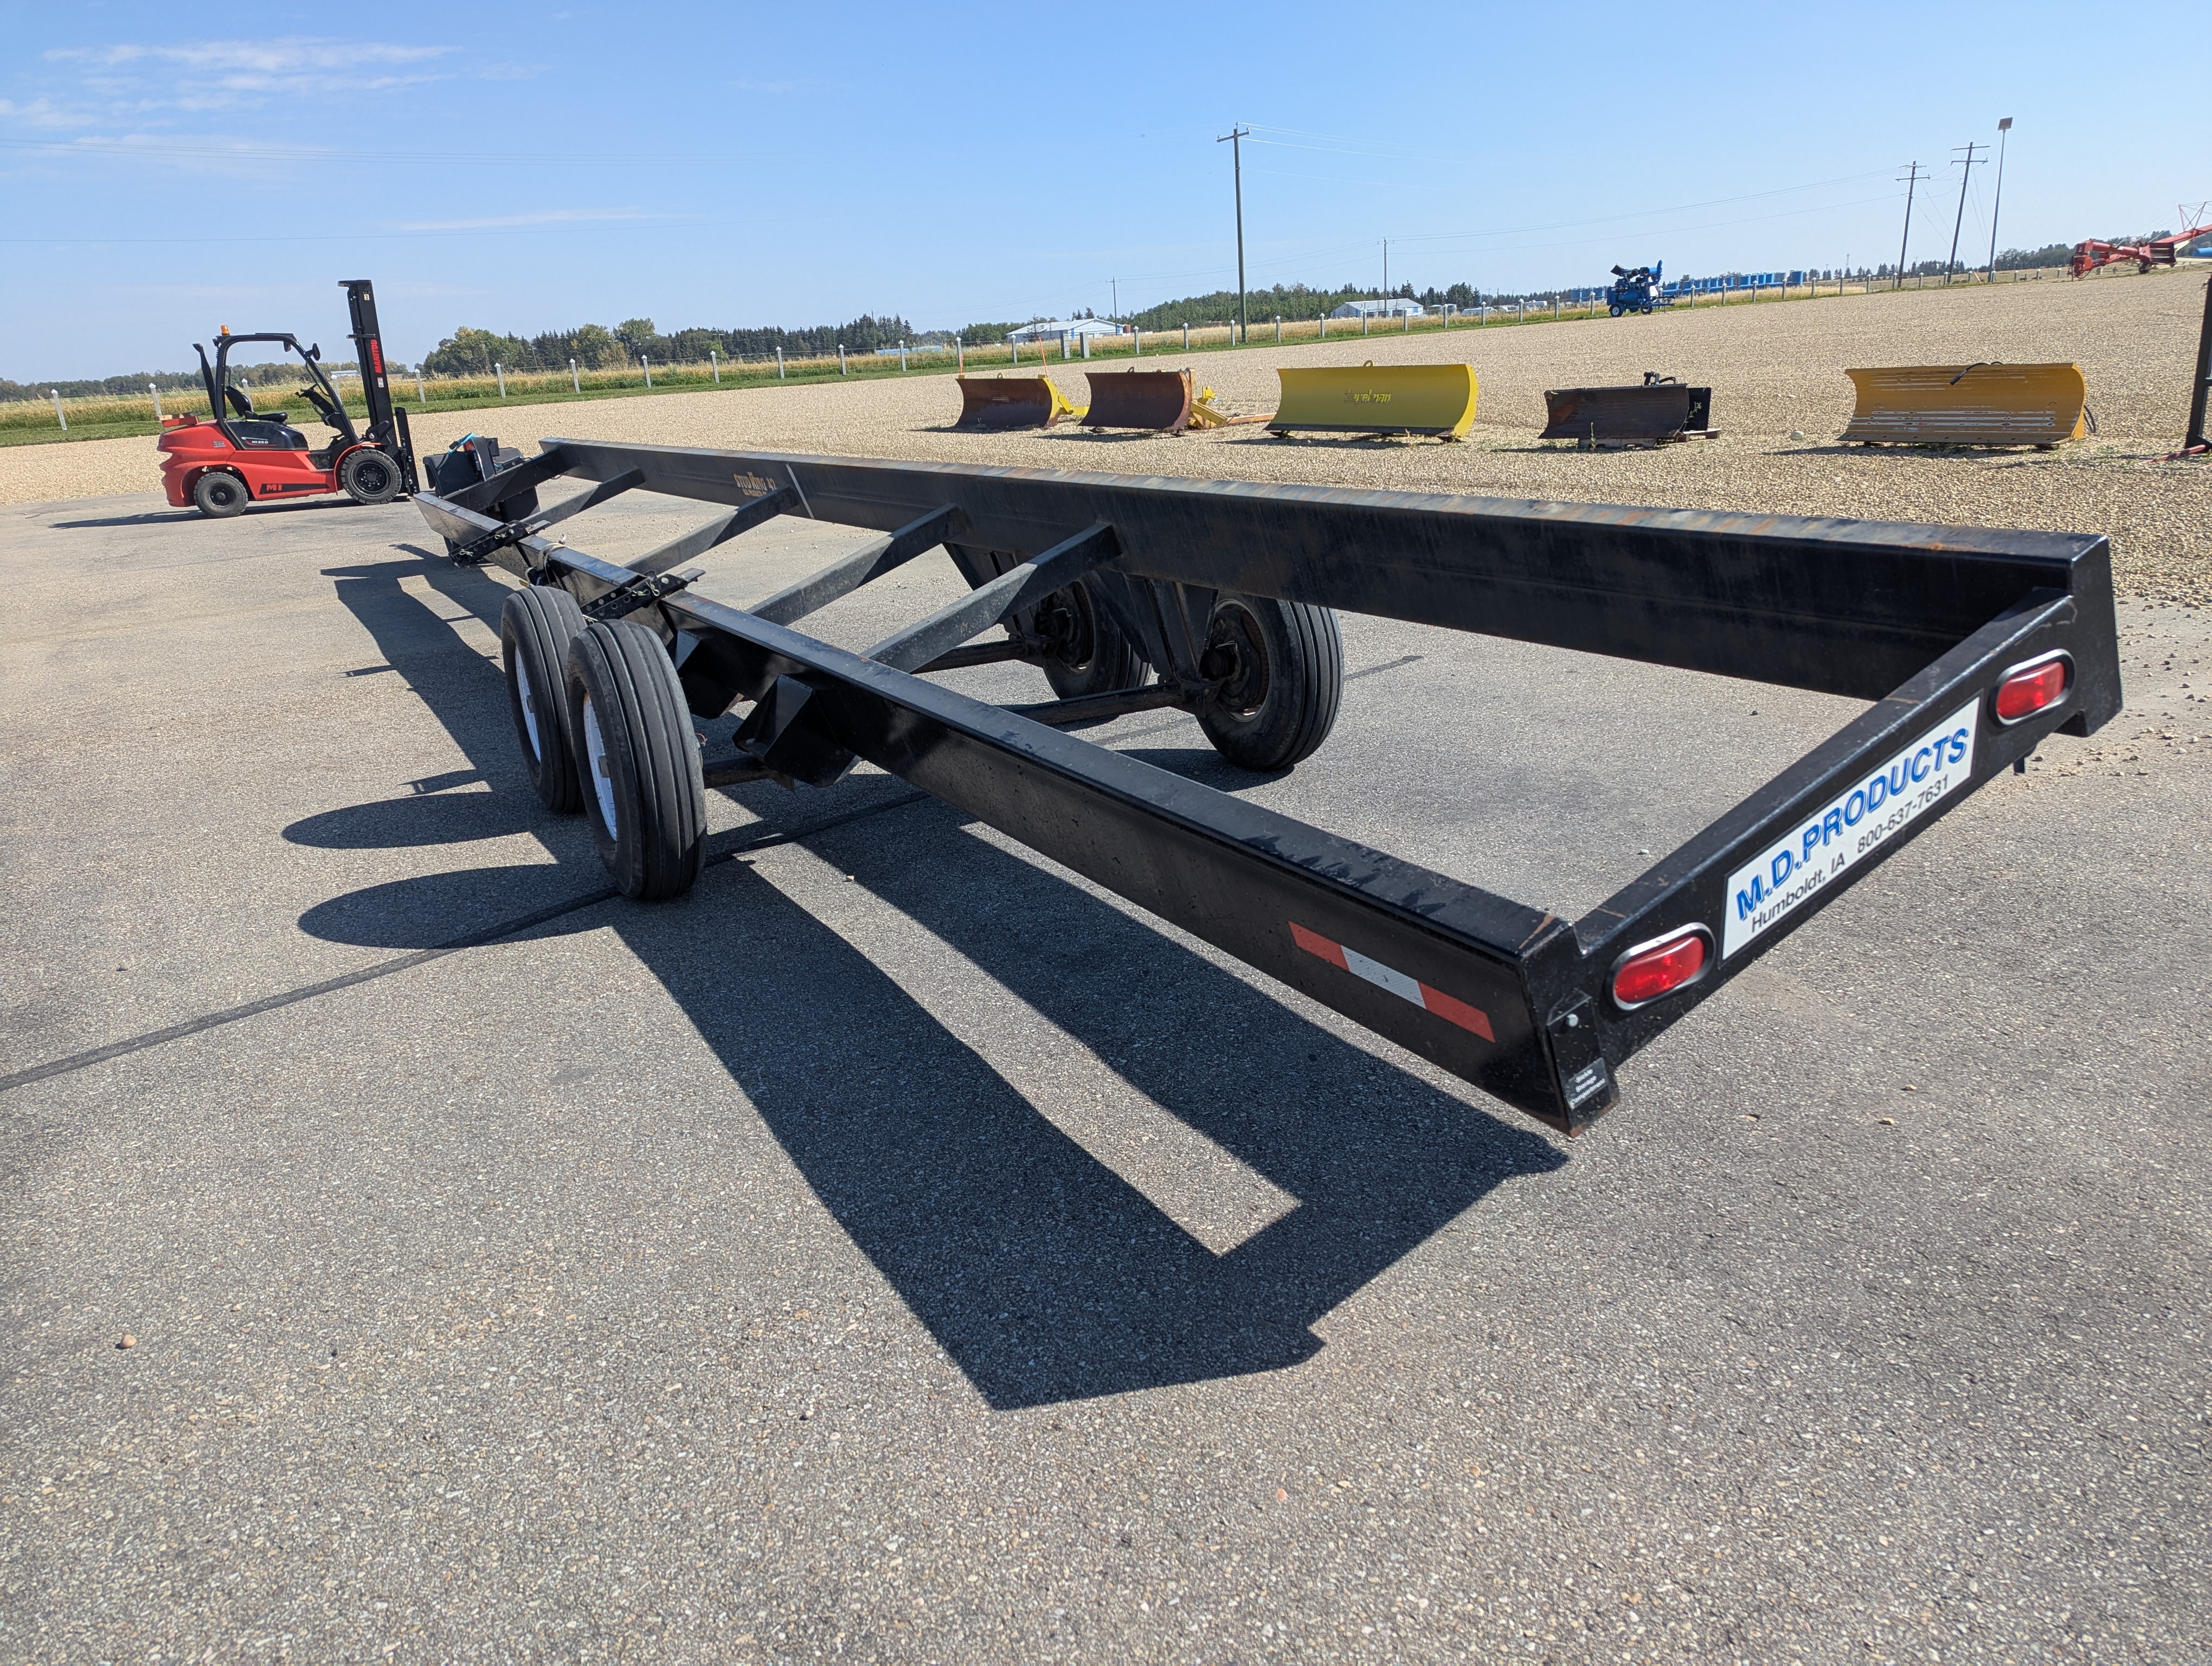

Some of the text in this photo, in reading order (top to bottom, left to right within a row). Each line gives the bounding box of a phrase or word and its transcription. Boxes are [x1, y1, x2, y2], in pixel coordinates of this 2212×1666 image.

[370, 339, 383, 373] MANITOU
[1751, 773, 1949, 933] Humboldt, IA 800-637-7631
[1574, 1068, 1593, 1083] Sickle
[1575, 1075, 1597, 1093] Storage
[1570, 1078, 1606, 1105] Compartment
